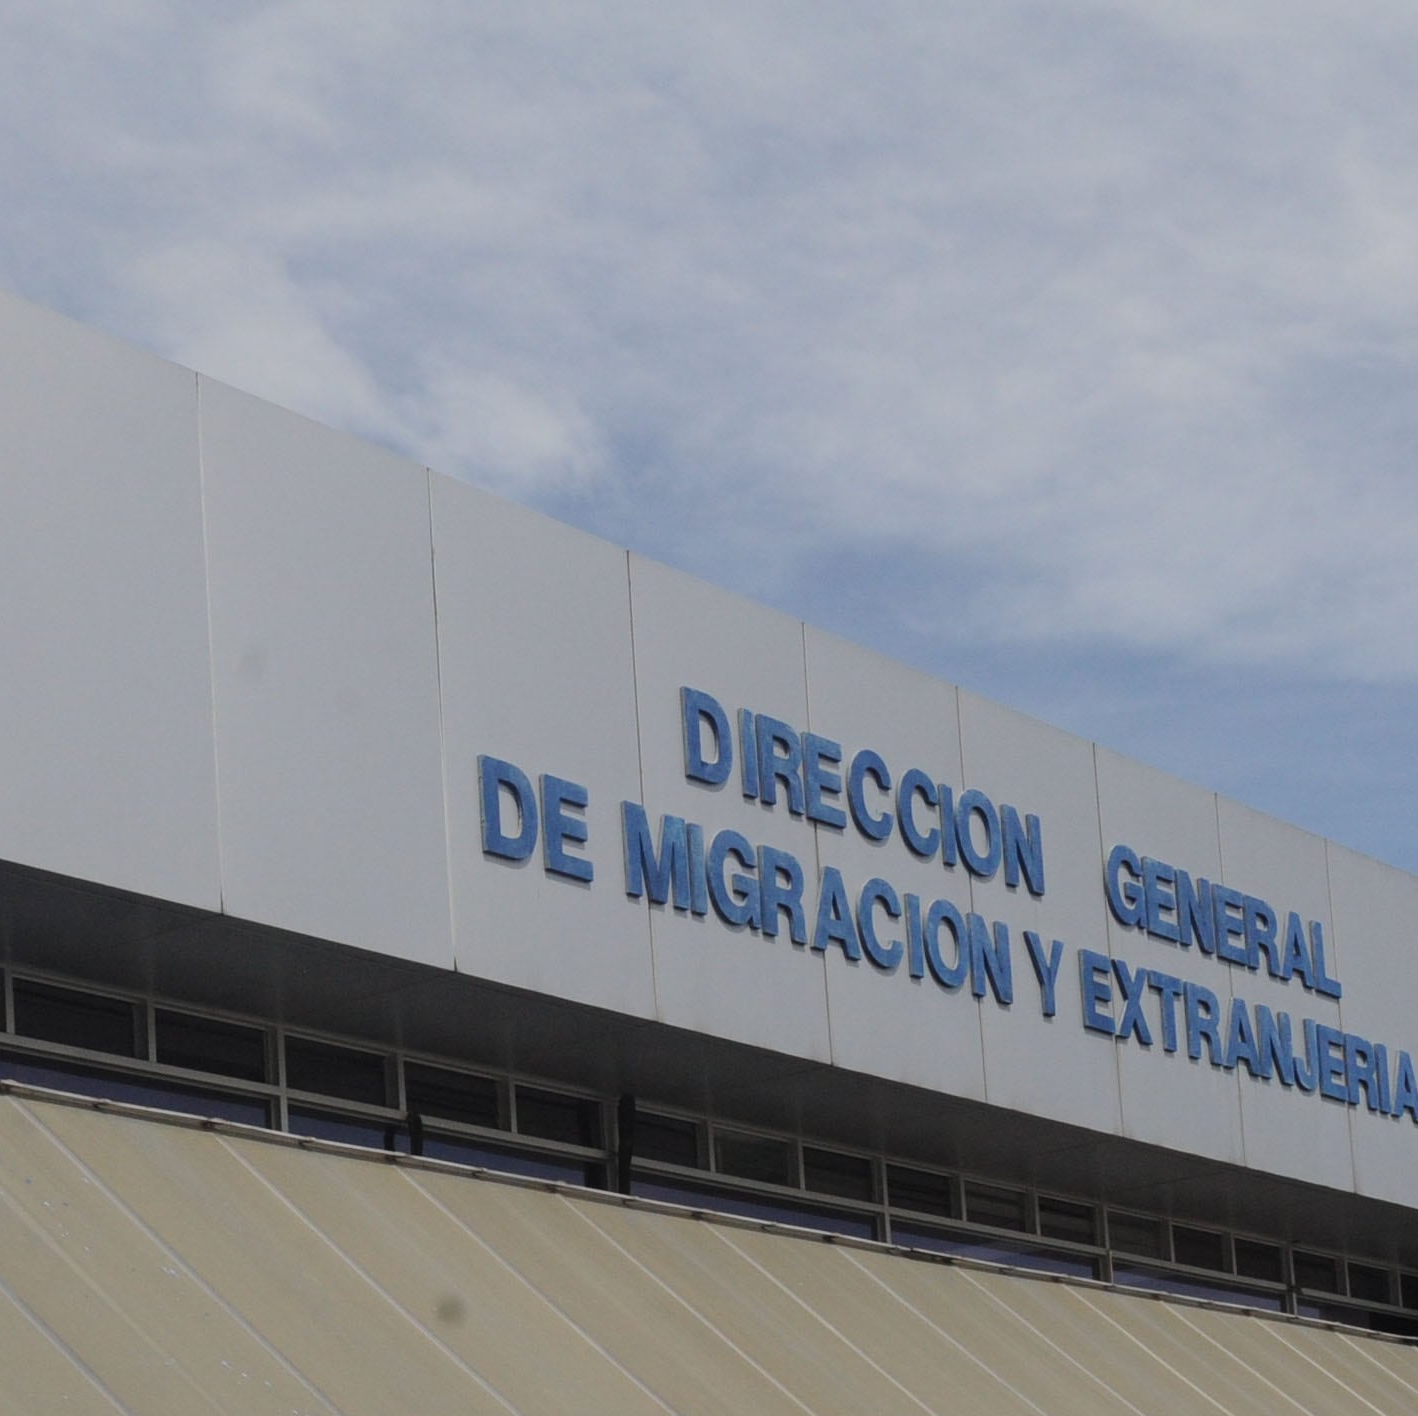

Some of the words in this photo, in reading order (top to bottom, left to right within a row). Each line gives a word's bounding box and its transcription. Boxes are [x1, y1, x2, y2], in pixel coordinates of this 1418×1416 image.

[477, 754, 594, 884] DE
[621, 800, 1014, 1006] MIGRACION
[1023, 930, 1065, 1017] Y
[680, 685, 1045, 897] DIRECCION
[1105, 844, 1342, 1000] GENERAL
